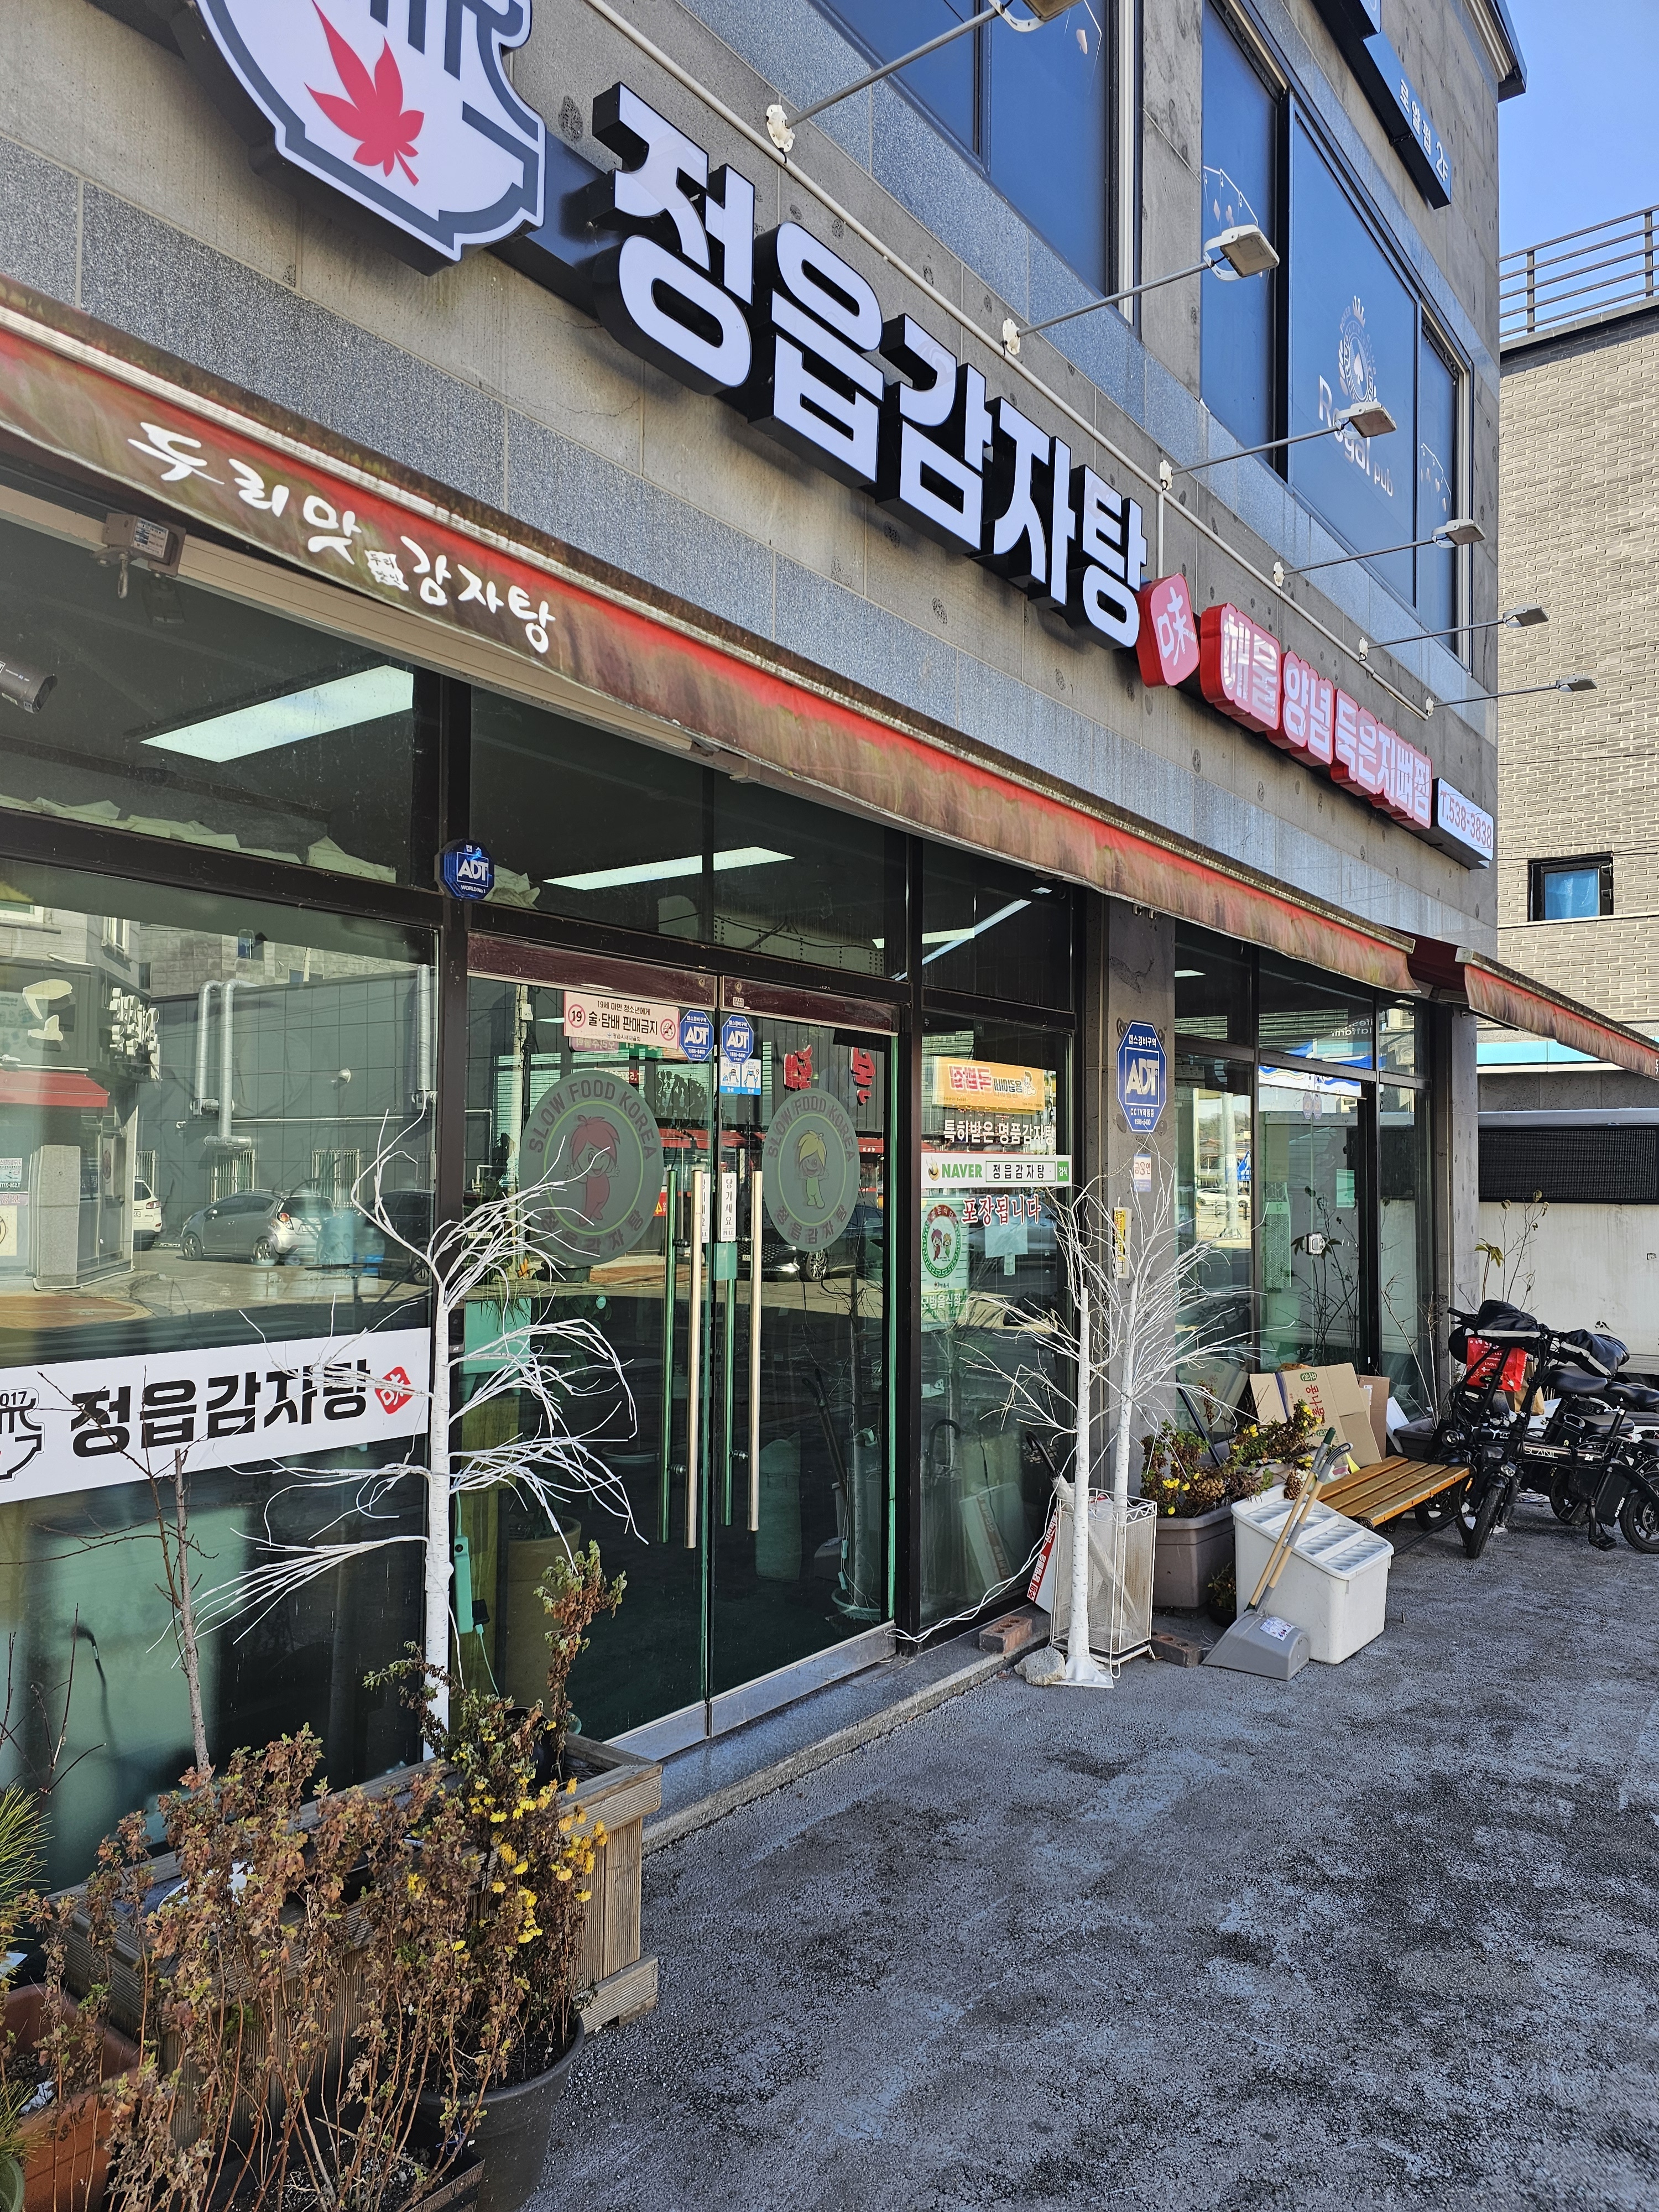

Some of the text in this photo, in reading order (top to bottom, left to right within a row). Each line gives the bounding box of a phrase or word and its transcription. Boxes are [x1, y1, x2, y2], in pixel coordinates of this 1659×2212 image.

[1400, 79, 1448, 182] 로얄펍 2F
[614, 81, 1147, 648] 정읍감자탕
[1374, 461, 1393, 497] pub
[400, 535, 555, 653] 감자탕
[1157, 586, 1197, 666] 味
[1223, 613, 1430, 822] 해물 양념 묵은지뼈찜
[1439, 790, 1492, 849] T.538-3838
[458, 859, 488, 881] ADT
[572, 1010, 582, 1022] 19
[597, 1000, 650, 1016] 19세 미만 청소년에게
[623, 1015, 658, 1035] 판매금지
[685, 1026, 708, 1045] ADT
[727, 1031, 749, 1049] ADT
[1129, 1034, 1156, 1047] 캡스경비구역
[1126, 1058, 1159, 1095] ADT
[529, 1079, 657, 1160] SLOW FOOD KOREA
[768, 1095, 855, 1162] SLOW FOOD KOREA
[1130, 1108, 1155, 1117] CCTV작동중
[943, 1119, 1054, 1145] 특허받은 명품감자탕
[942, 1164, 1068, 1179] NAVER 정읍감자탕 검색
[776, 1204, 847, 1244] 정읍감자탕
[962, 1194, 1041, 1226] 포장됩니다
[921, 1293, 960, 1310] 모범음식점
[71, 1359, 371, 1458] 정읍감자탕
[1306, 1385, 1324, 1416] 콩나물
[1028, 1584, 1037, 1598] 주의
[1033, 1553, 1046, 1583] 당일배송
